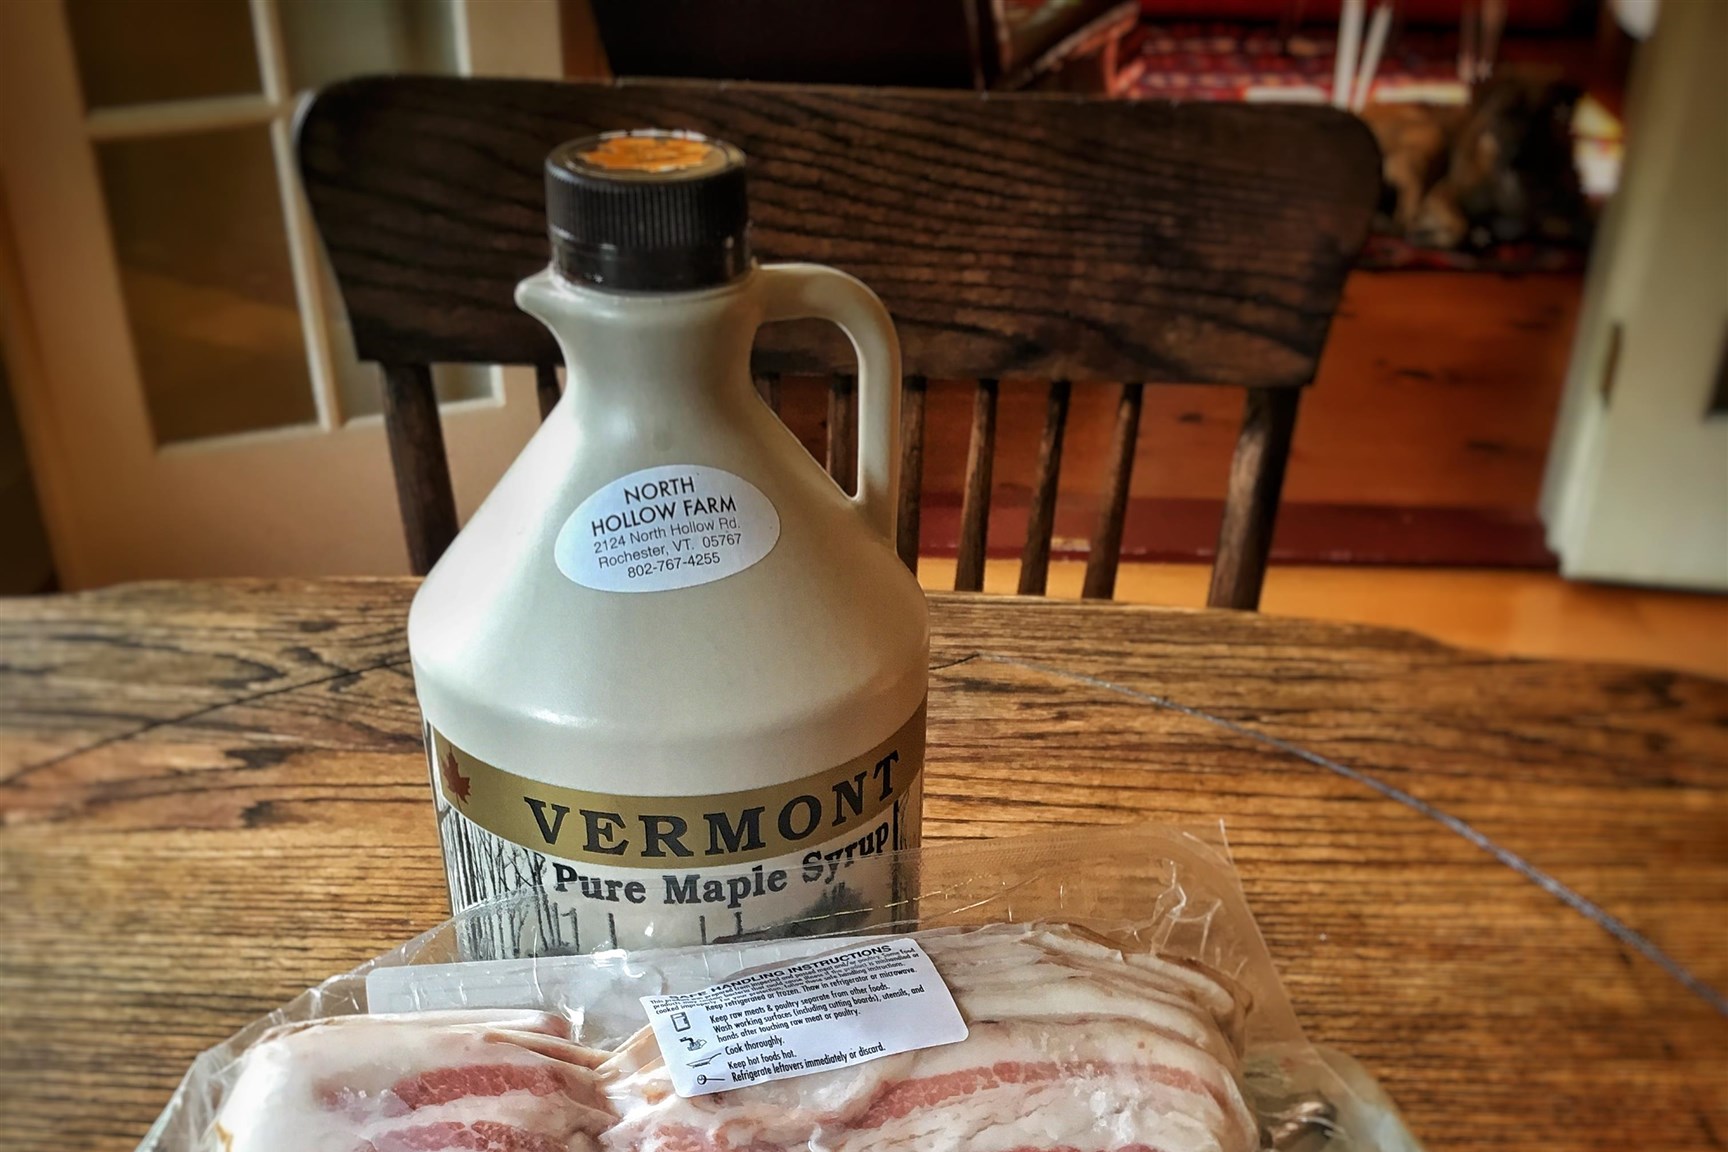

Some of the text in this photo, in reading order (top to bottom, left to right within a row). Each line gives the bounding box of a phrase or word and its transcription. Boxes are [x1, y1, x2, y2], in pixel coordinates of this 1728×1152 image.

[624, 476, 695, 504] NORTH
[591, 495, 737, 537] HOLLOW FARM
[594, 516, 741, 553] 2124 North Hollow Rd.
[598, 533, 742, 568] Rochester, VT. 05767
[627, 552, 721, 578] 802-767-4255
[523, 750, 900, 857] VERMONT
[553, 822, 890, 909] Pure Maple Syrup
[711, 971, 785, 992] HANDLING
[788, 945, 892, 975] INSTRUCTIONS
[705, 1002, 724, 1012] Keep
[725, 993, 767, 1007] refrigerated
[767, 991, 775, 999] or
[776, 986, 802, 998] frozen.
[802, 981, 823, 992] Thaw
[822, 981, 830, 989] in
[830, 974, 869, 988] refrigerator
[879, 966, 917, 979] microwave.
[709, 982, 891, 1025] Keep raw meats & poultry separate from other foods.
[712, 984, 926, 1034] Wash working surfaces (including cutting boards), utensils, and
[717, 1008, 861, 1043] hands after touching raw meat or poultry.
[725, 1035, 786, 1056] Cook thoroughly.
[727, 1048, 797, 1071] Keep hot foods hot.
[731, 1042, 887, 1082] Refrigerate leftovers immediately or discard.
